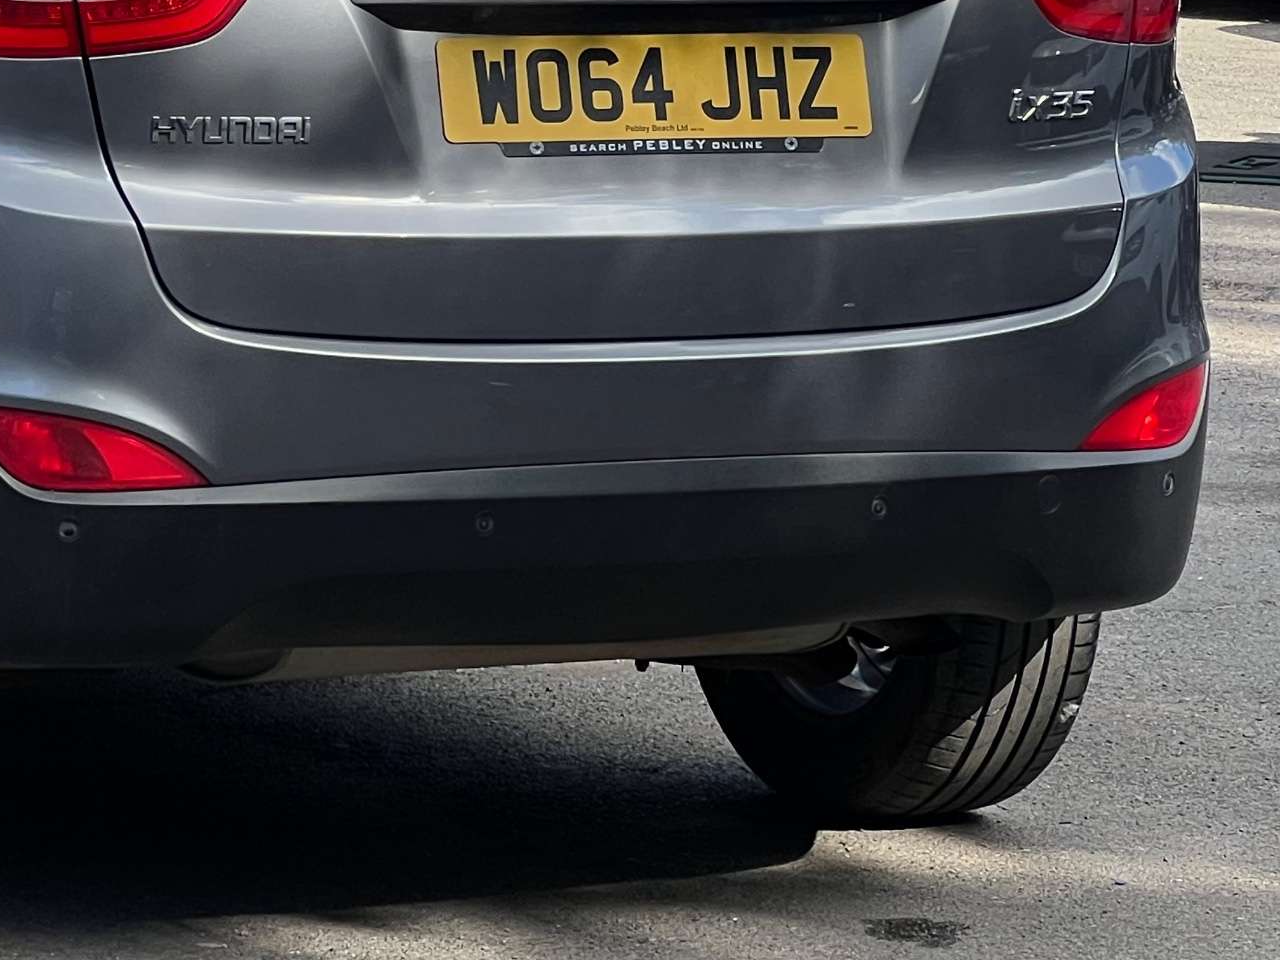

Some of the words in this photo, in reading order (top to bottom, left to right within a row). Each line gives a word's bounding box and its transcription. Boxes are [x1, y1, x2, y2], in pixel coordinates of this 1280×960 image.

[472, 47, 674, 125] WO64
[701, 45, 839, 121] JHZ
[1008, 88, 1095, 122] ix35
[151, 115, 312, 144] HYUNDAI
[569, 142, 627, 152] SEARCH
[632, 139, 707, 151] PEBLEY
[711, 140, 763, 150] ONLINE
